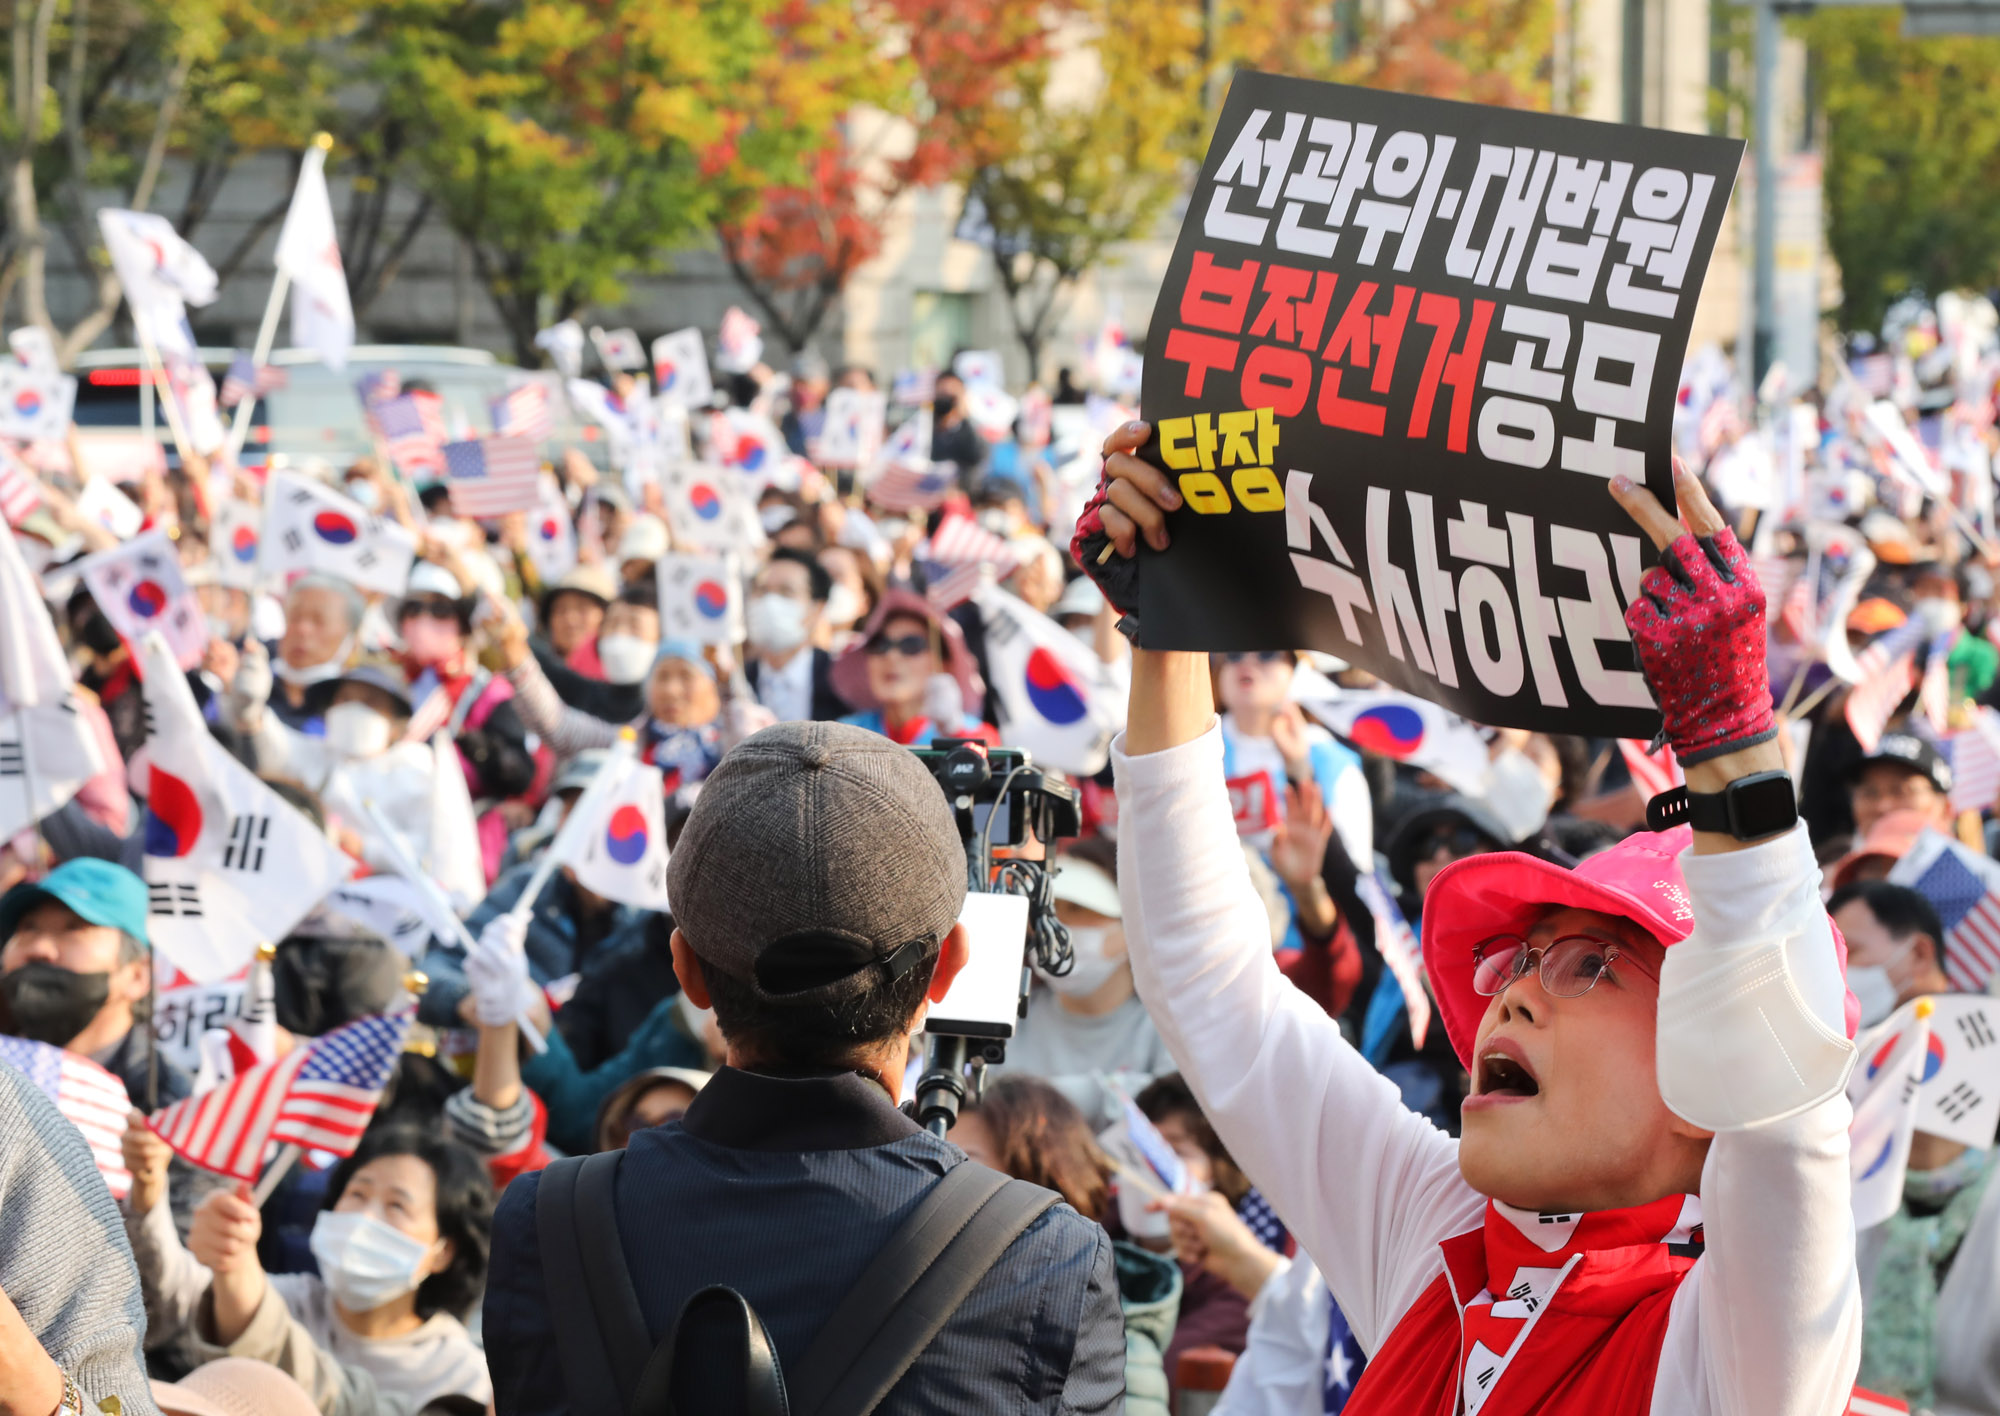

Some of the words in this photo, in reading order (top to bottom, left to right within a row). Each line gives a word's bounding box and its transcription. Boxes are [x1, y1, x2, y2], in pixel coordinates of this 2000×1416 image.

[1164, 251, 1496, 453] 부정선거
[1477, 304, 1661, 485] 공모
[1158, 407, 1286, 515] 당장
[1285, 469, 1657, 709] 수사하라
